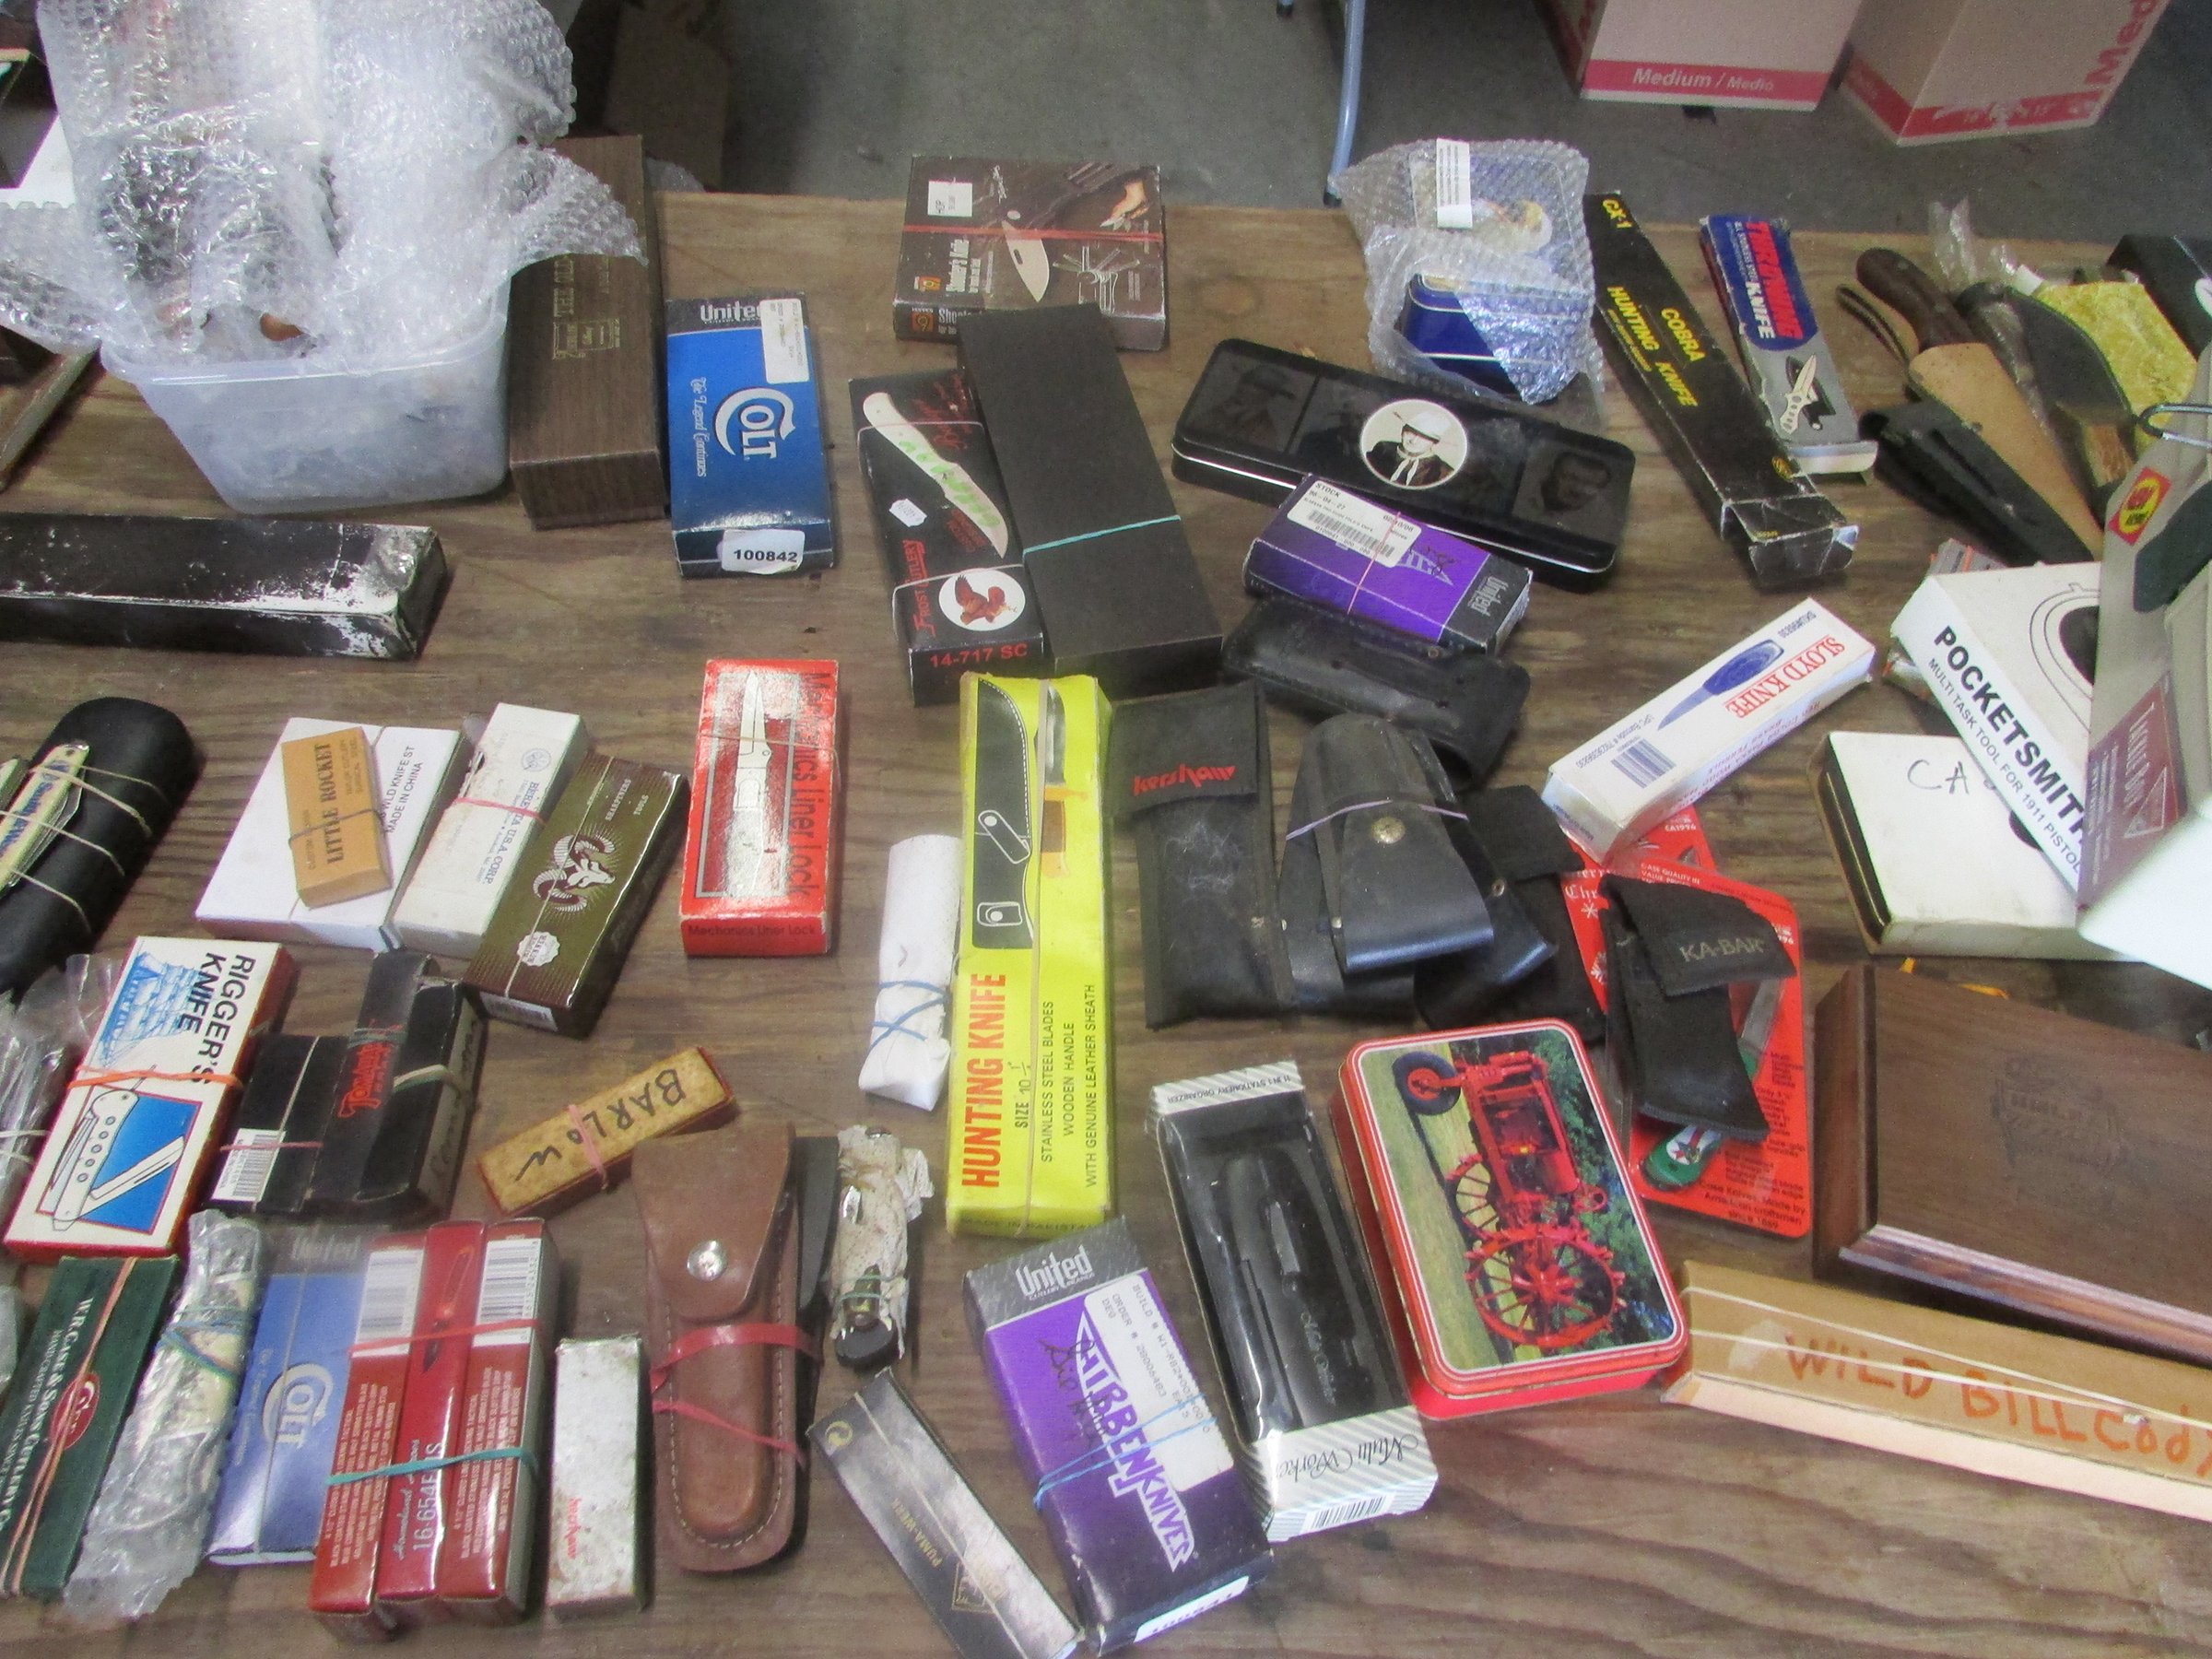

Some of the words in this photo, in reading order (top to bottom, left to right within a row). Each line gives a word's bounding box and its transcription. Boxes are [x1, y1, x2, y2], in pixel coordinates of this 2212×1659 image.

[1633, 68, 1712, 88] Medium
[1727, 76, 1775, 90] Medio
[1602, 198, 1633, 229] CX-1
[1746, 280, 1776, 339] KNIFE
[1606, 287, 1660, 351] HUNTING
[1654, 361, 1699, 406] KNIFE
[1660, 308, 1706, 361] COBRA
[691, 394, 709, 429] Legend
[692, 430, 709, 477] Continues
[1315, 482, 1341, 499] STOCK
[733, 548, 798, 564] 100842
[901, 537, 930, 588] CUTLERY
[912, 585, 937, 637] FROST
[1467, 575, 1510, 617] United
[929, 647, 994, 668] 14-717
[1000, 642, 1029, 659] SC
[1783, 634, 1846, 682] SLOYD
[1724, 665, 1792, 719] KNIFE
[1928, 657, 1954, 697] MULTI
[1952, 695, 1978, 730] TASK
[1975, 728, 2001, 766] TOOL
[1999, 763, 2024, 794] FOR
[2022, 793, 2046, 823] 1911
[313, 744, 337, 803] ROCKET
[392, 761, 409, 787] KNIFE
[403, 746, 416, 759] ST
[1132, 763, 1238, 797] kershaw
[387, 806, 406, 833] MADE
[400, 792, 410, 806] IN
[406, 762, 423, 793] CHINA
[511, 779, 539, 828] BERETA
[633, 794, 650, 817] TOOLS
[790, 788, 826, 837] Liner
[323, 807, 345, 865] LITTLE
[482, 853, 503, 887] CORP.
[787, 844, 823, 897] Lock
[1641, 870, 1664, 881] VALUE
[1662, 868, 1691, 882] QUALITY
[757, 924, 786, 936] Liner
[788, 924, 816, 935] Lock
[1678, 936, 1765, 962] KA-BAR
[177, 952, 228, 1035] KNIFE
[968, 973, 1006, 1050] KNIFE
[1084, 984, 1097, 1031] SHEATH
[192, 953, 257, 1086] RIGGER'S
[1041, 1001, 1054, 1047] BLADES
[1041, 1051, 1054, 1088] STEEL
[1063, 1022, 1076, 1071] HANDLE
[1084, 1034, 1098, 1088] LEATHER
[1063, 1076, 1076, 1137] WOODEN
[1167, 1088, 1215, 1103] ORGANIZER
[1217, 1078, 1266, 1095] STATIONERY
[961, 1058, 1005, 1188] HUNTING
[1015, 1101, 1030, 1129] SIZE
[1041, 1092, 1053, 1163] STAINLESS
[1084, 1089, 1098, 1150] GENUINE
[1085, 1155, 1098, 1188] WITH
[1016, 1244, 1094, 1297] United
[1112, 1293, 1134, 1329] ORDER
[1350, 1430, 1420, 1470] Multi
[1119, 1464, 1194, 1558] KNIVES
